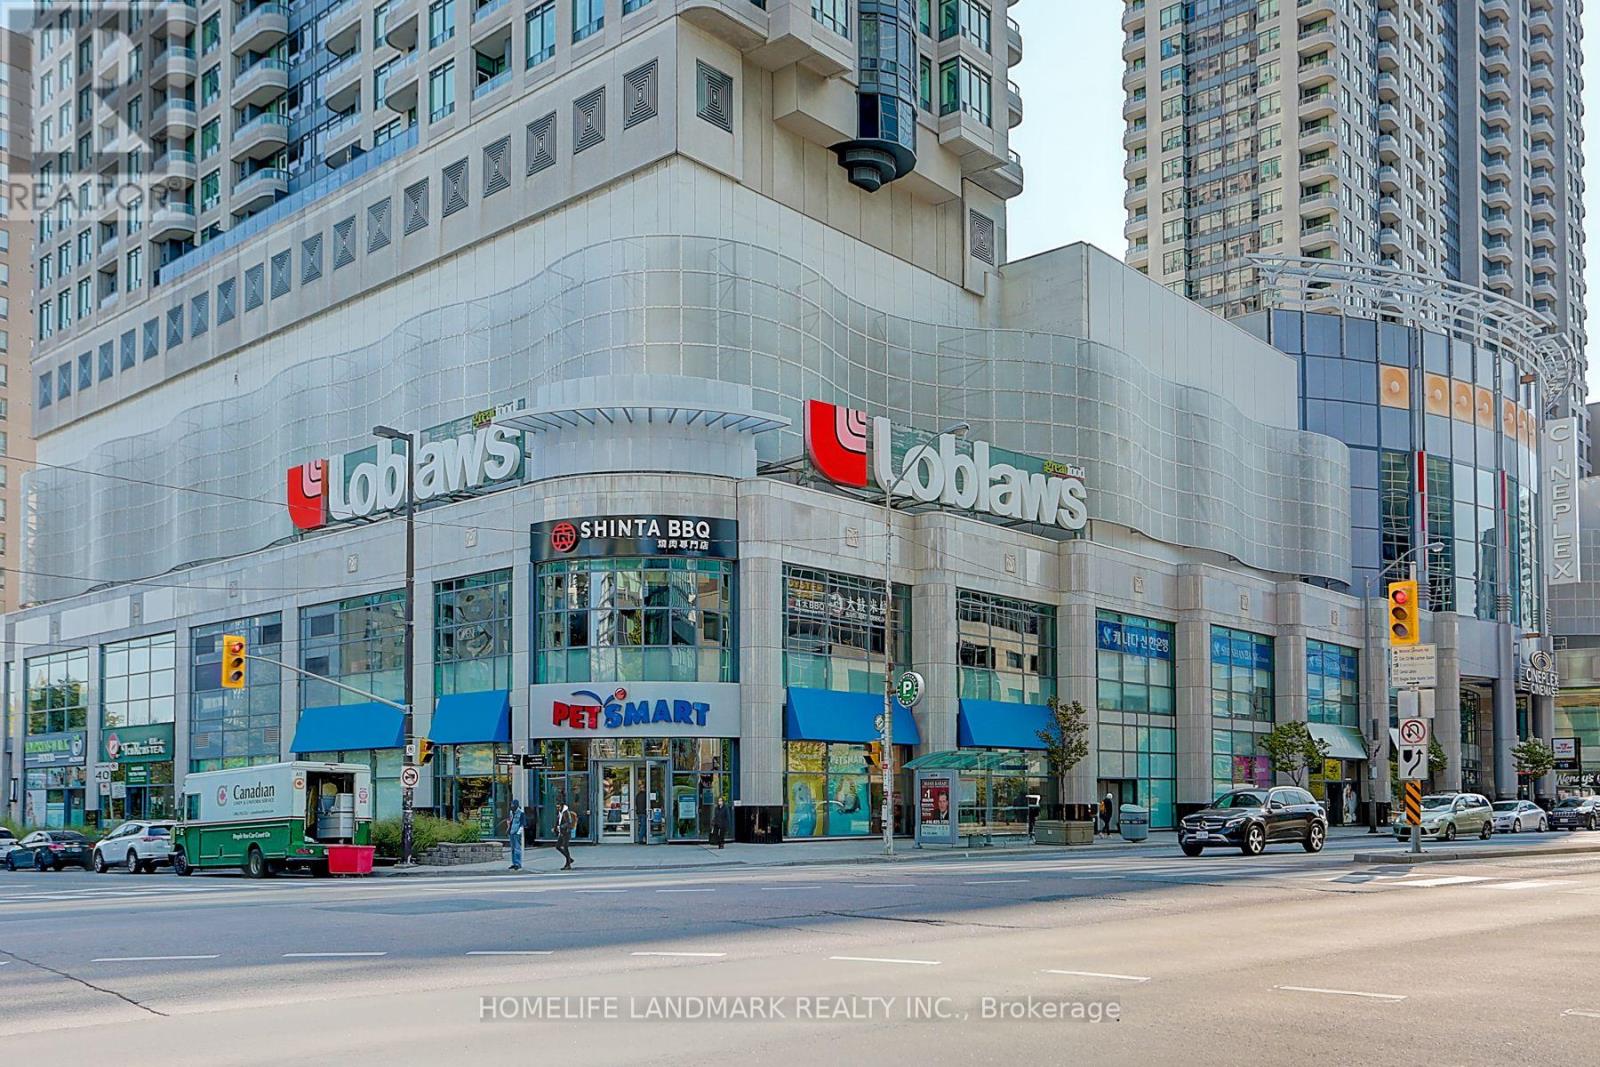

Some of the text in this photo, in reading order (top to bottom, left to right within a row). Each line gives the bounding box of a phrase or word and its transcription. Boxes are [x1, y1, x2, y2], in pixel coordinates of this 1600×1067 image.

[328, 424, 521, 521] Loblaws
[873, 415, 1088, 530] Loblaws
[1549, 424, 1574, 580] CINEPLEX
[580, 519, 710, 538] SHINTA BBQ
[1140, 635, 1168, 652] 신한은행
[1526, 667, 1559, 688] CINEPLEX
[902, 680, 912, 695] P
[96, 770, 110, 780] 40
[233, 781, 274, 800] Canadian
